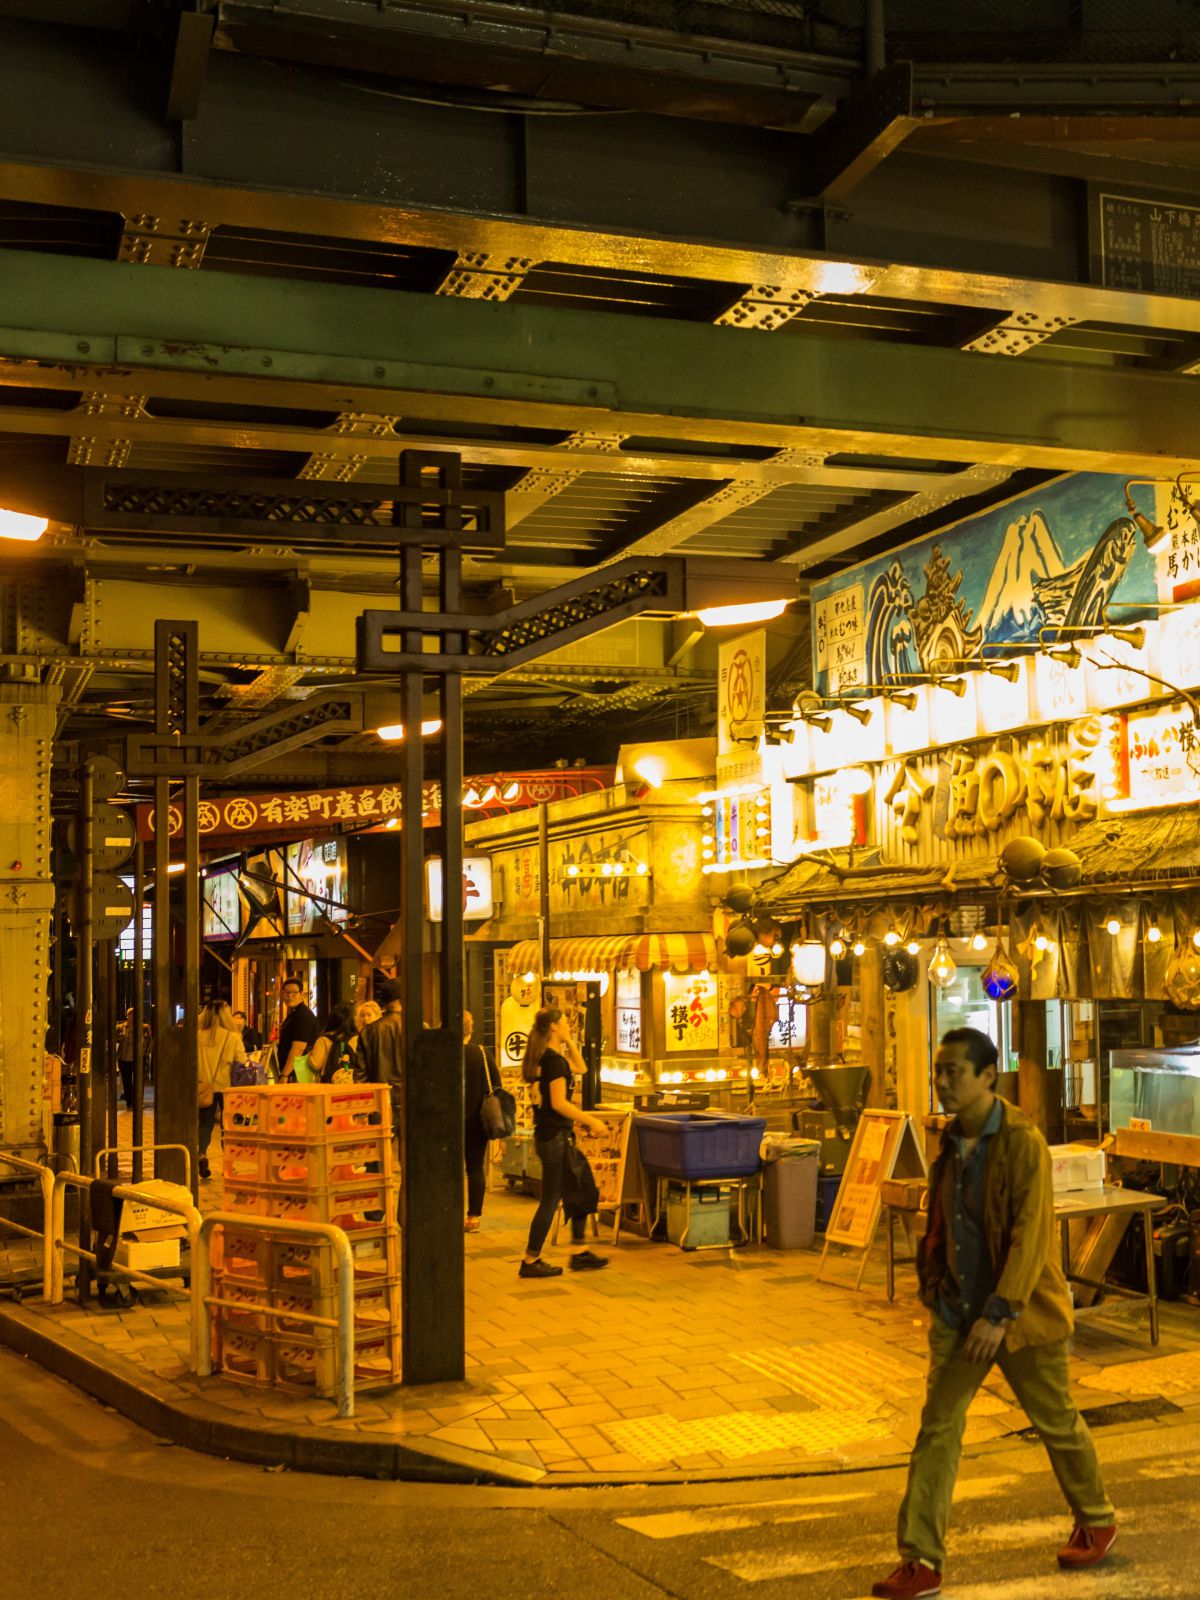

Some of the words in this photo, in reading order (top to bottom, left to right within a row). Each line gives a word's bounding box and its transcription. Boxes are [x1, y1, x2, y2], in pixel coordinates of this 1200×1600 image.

[260, 784, 442, 823] 有楽町産直飲
[671, 1005, 689, 1041] 横丁
